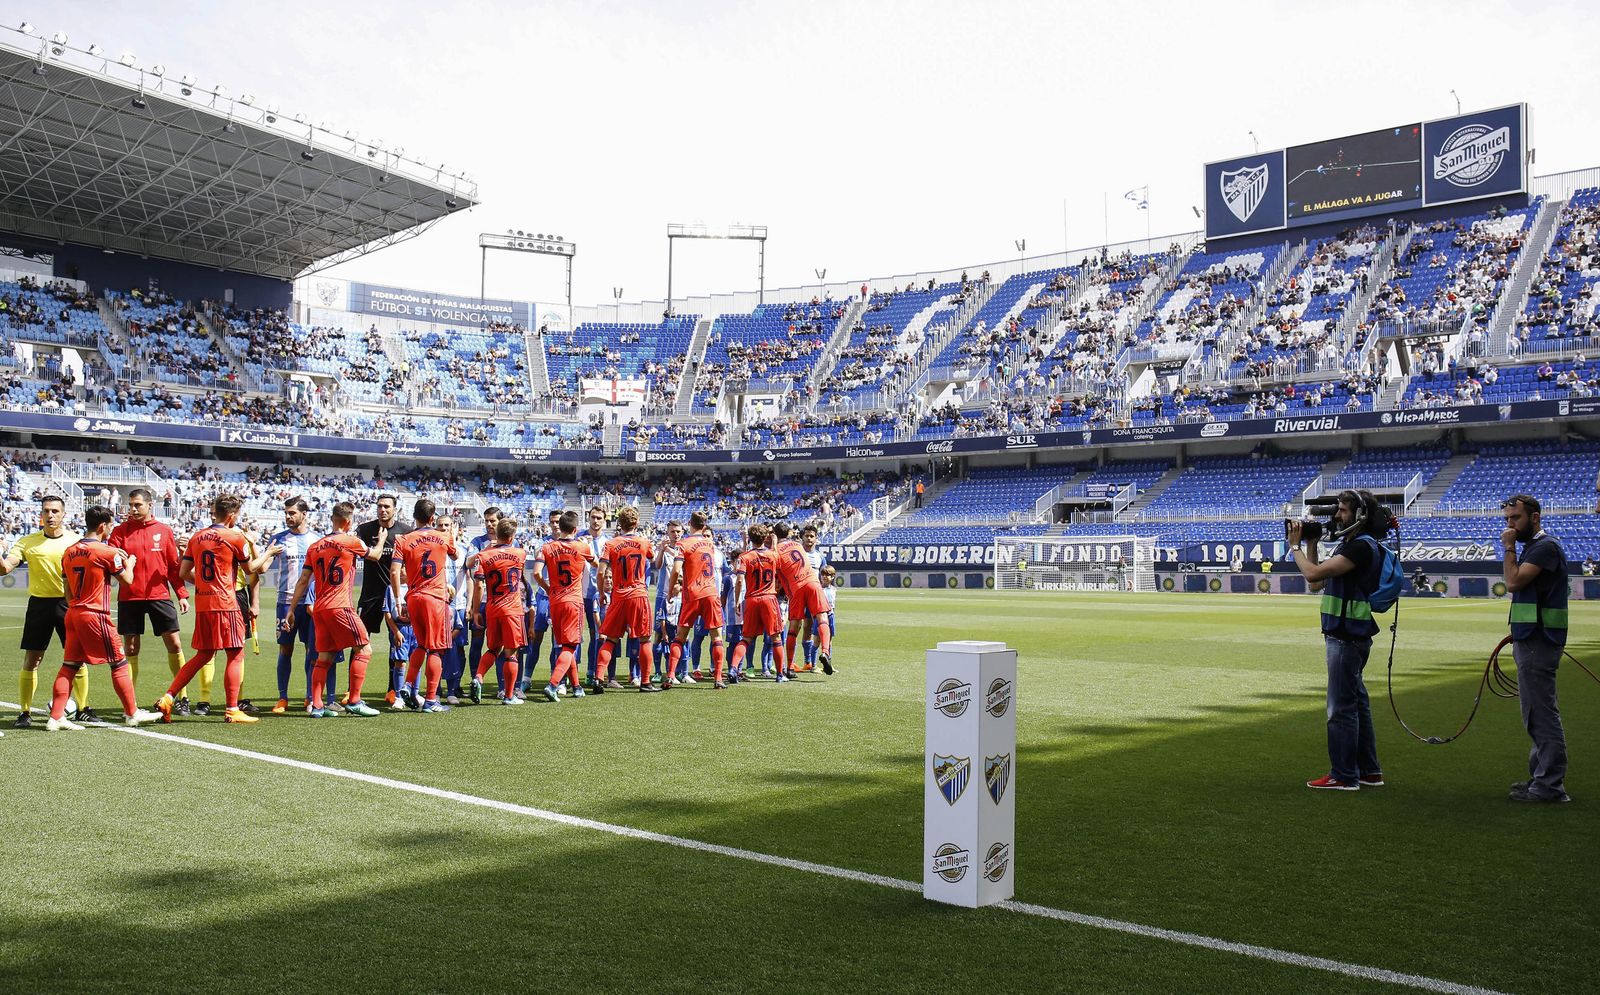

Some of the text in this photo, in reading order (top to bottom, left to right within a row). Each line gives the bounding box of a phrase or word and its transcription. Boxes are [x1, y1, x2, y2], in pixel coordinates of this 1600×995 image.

[1303, 204, 1312, 212] EL
[1314, 198, 1349, 210] MÁLAGA
[1351, 197, 1363, 205] VA
[1374, 190, 1403, 201] JUGAR
[371, 290, 420, 304] FEDERACIÓN
[432, 298, 458, 308] PEÑAS
[460, 301, 513, 313] MALAGUISTAS
[371, 299, 513, 325] FÚTBOL SI VIOLENCIA NO
[1113, 426, 1175, 436] DOÑA FRANCISQUITA
[1274, 416, 1339, 432] Rivervial
[243, 431, 291, 446] CaixaBank
[1007, 435, 1037, 445] SUR
[509, 448, 552, 456] MARATHON
[647, 453, 686, 461] BESOCCER
[409, 535, 444, 550] H.MORENO
[421, 550, 437, 579] 6
[701, 552, 714, 577] 3
[790, 550, 805, 568] 9
[819, 546, 895, 562] FRENTE
[912, 546, 1014, 564] BOKERON
[1048, 544, 1121, 562] FONDO
[1201, 544, 1263, 562] 1904
[202, 550, 215, 581] 8
[316, 556, 344, 586] 16
[558, 560, 572, 587] 5
[619, 554, 642, 582] 17
[72, 566, 86, 600] 7
[488, 567, 519, 595] 20
[1034, 582, 1076, 591] TURKISH
